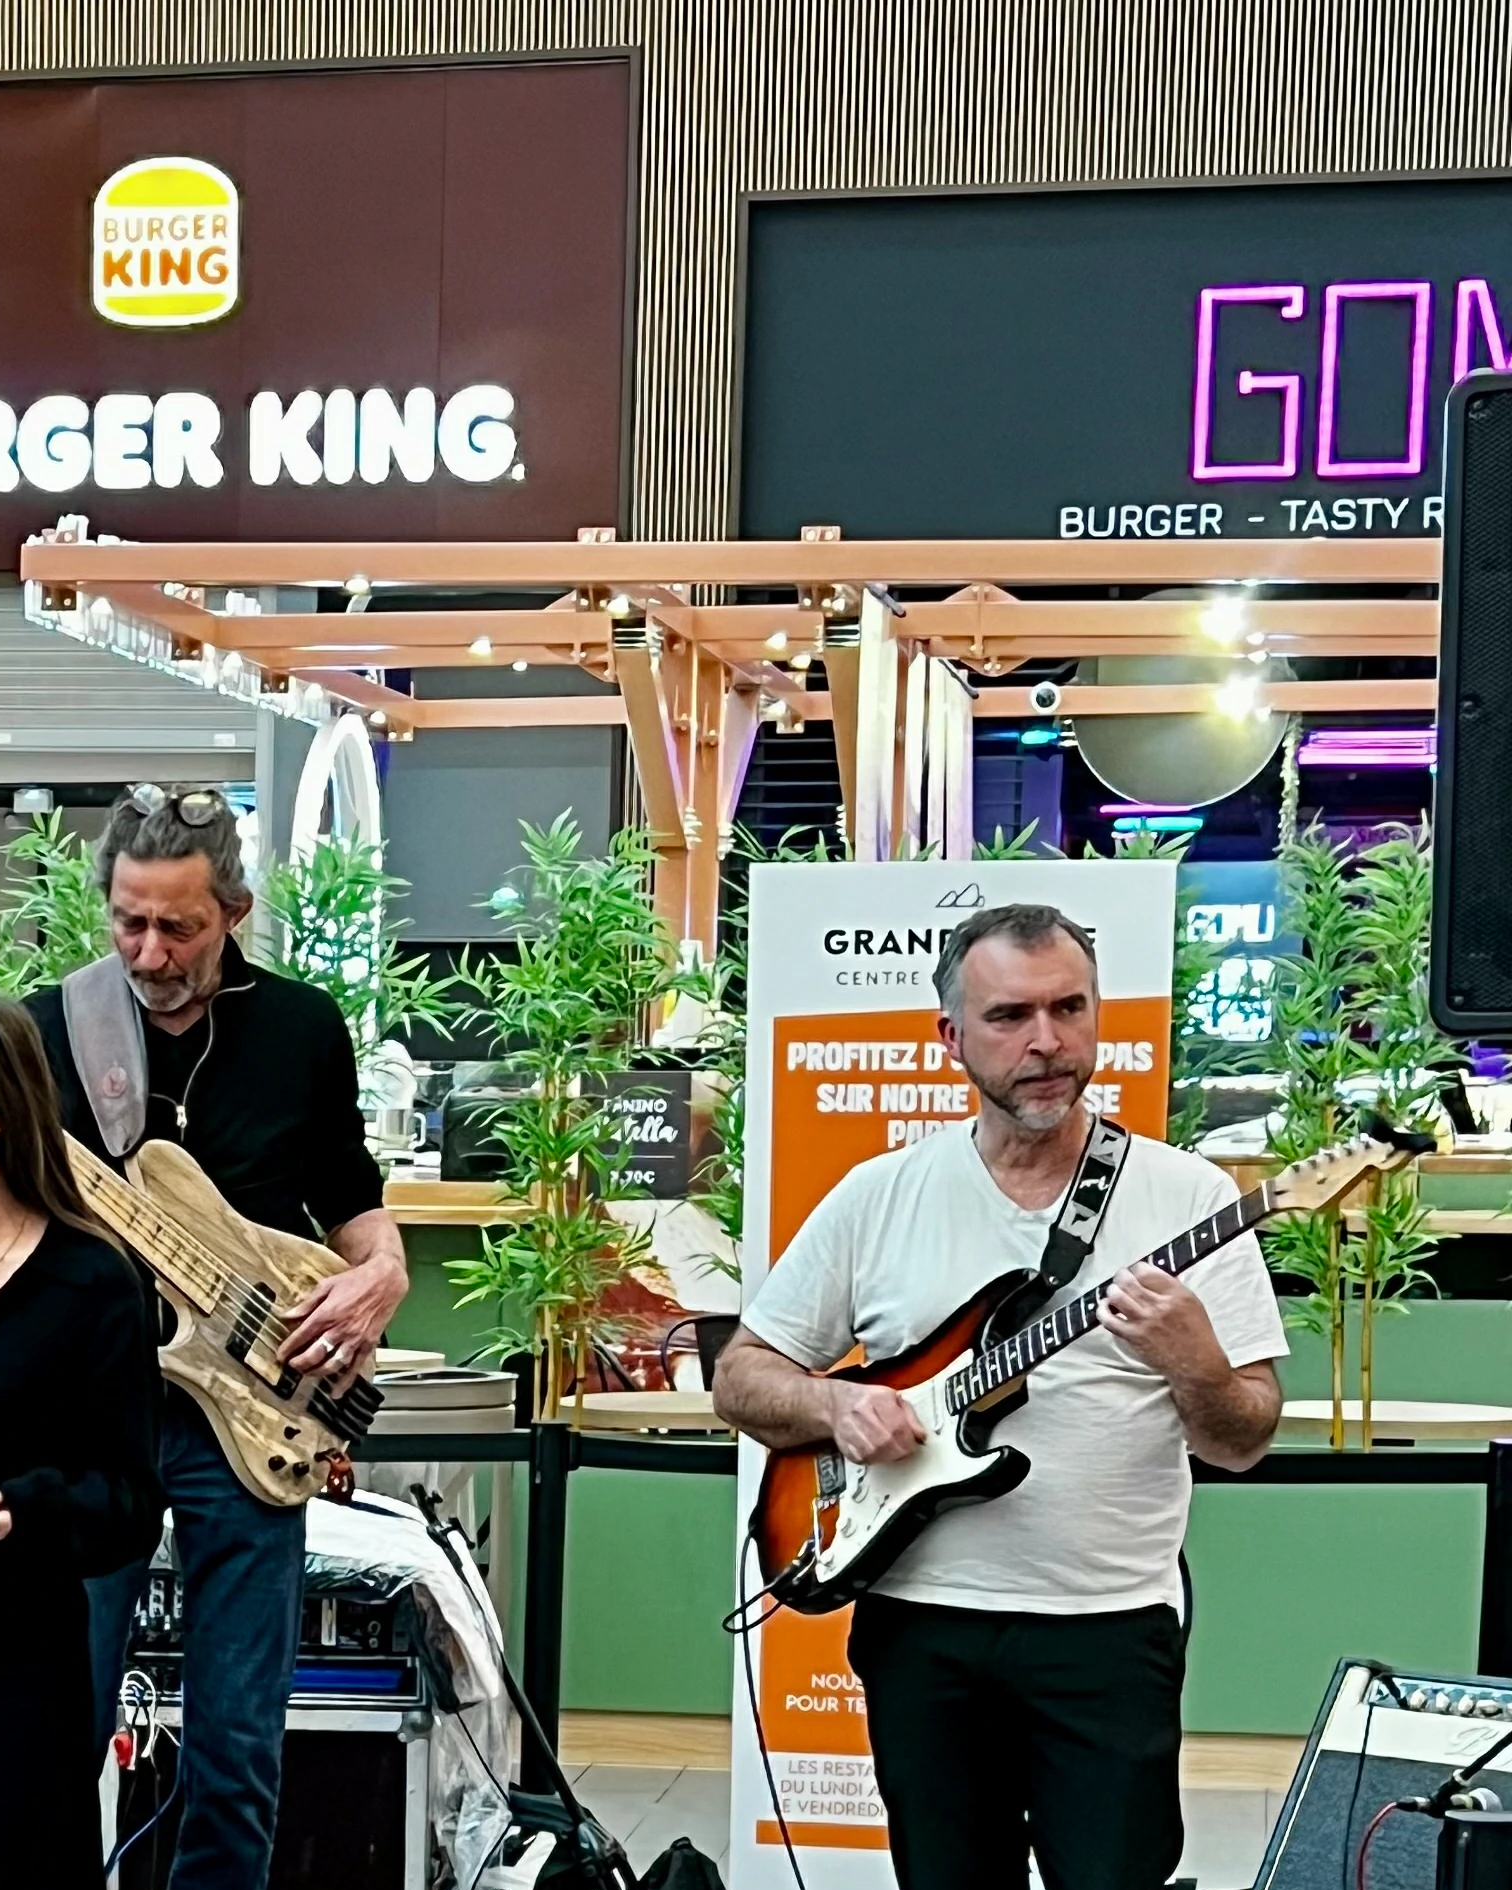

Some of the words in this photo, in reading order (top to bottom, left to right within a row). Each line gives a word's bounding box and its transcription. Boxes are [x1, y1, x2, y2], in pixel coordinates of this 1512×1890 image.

[102, 215, 229, 243] BURGER
[102, 246, 229, 287] KING
[1059, 503, 1223, 538] BURGER
[1281, 499, 1409, 532] TASTY
[836, 971, 920, 986] CENTRE
[787, 1041, 918, 1072] PROFITEZ
[816, 1083, 873, 1113] SUR
[880, 1084, 969, 1113] NOTRE
[785, 1694, 839, 1712] POUR
[788, 1759, 818, 1775] LES
[780, 1779, 805, 1794] DU
[810, 1780, 863, 1797] LUNDI
[798, 1799, 884, 1817] VENDREDI
